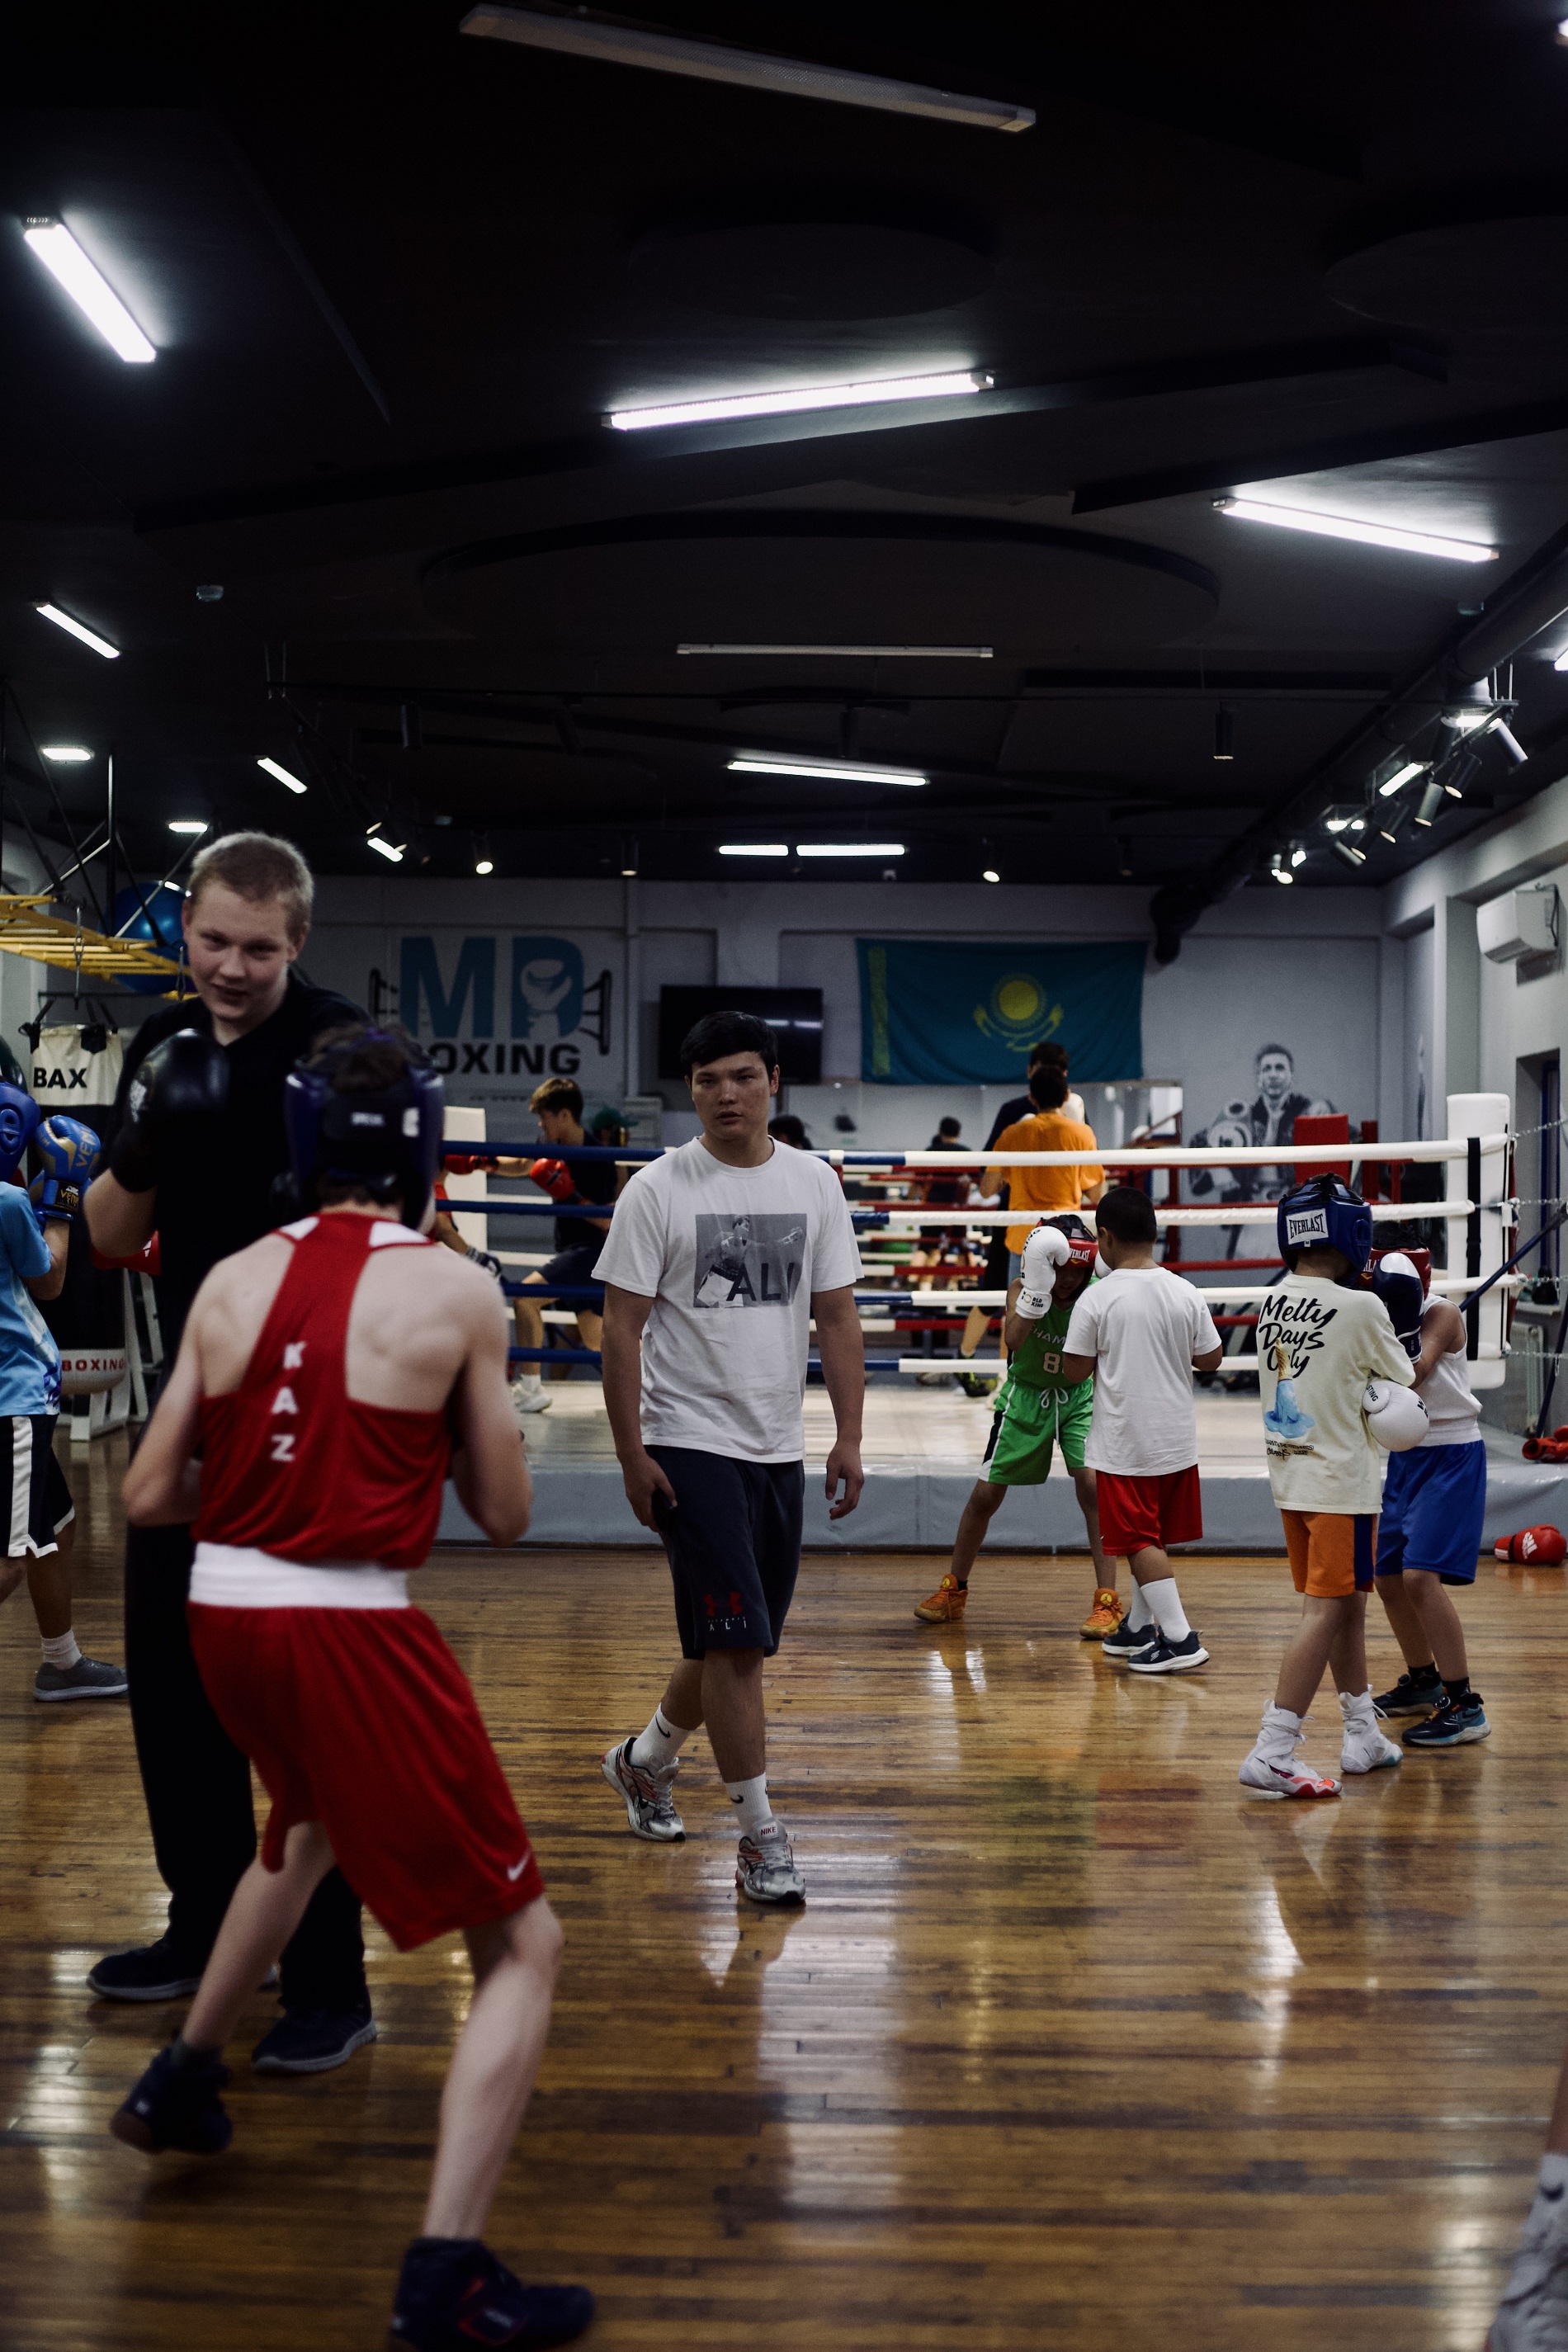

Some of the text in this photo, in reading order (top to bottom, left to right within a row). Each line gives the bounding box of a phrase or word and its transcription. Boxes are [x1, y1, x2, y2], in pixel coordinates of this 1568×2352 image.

[429, 1043, 580, 1074] OXING
[34, 1068, 87, 1089] BAX
[1289, 1214, 1325, 1239] EVERLAST
[1070, 1248, 1091, 1263] VERLAST
[726, 1263, 795, 1301] ALI
[1259, 1295, 1338, 1329] Melty
[1031, 1324, 1066, 1344] HAM
[1259, 1322, 1325, 1353] Days
[1043, 1352, 1064, 1374] 8
[1267, 1346, 1310, 1378] Oly
[270, 1340, 308, 1462] KAZ
[1366, 1384, 1379, 1402] STING
[761, 1826, 776, 1835] NIKE
